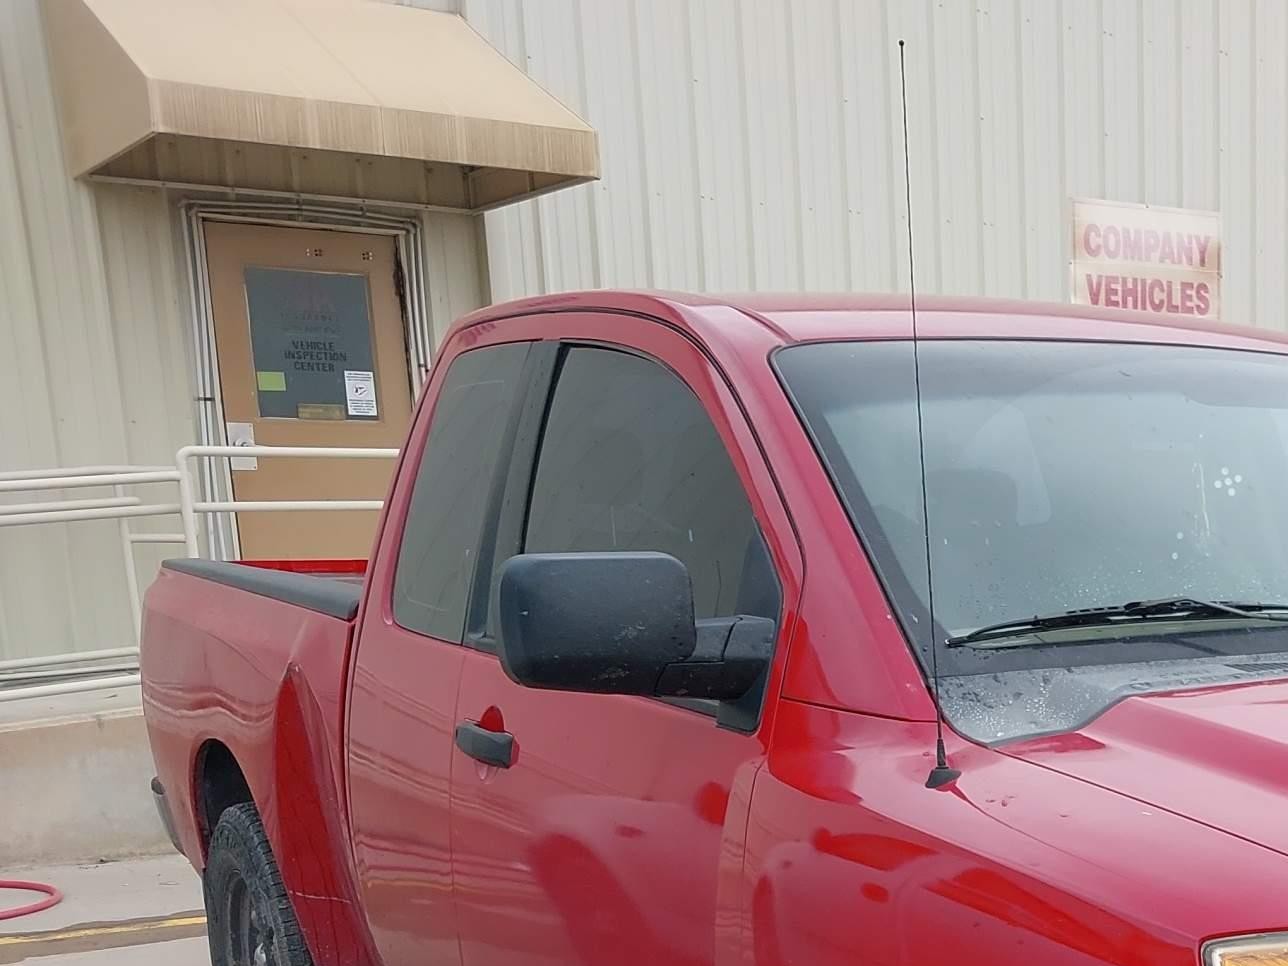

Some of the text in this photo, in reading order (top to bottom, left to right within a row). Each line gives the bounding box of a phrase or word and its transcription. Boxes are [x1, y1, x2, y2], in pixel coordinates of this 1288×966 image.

[1083, 223, 1212, 268] COMPANY
[1085, 273, 1211, 316] VEHICLES
[291, 340, 335, 351] VEHICLE
[283, 350, 348, 362] INSPECTION
[294, 361, 336, 372] CENTER
